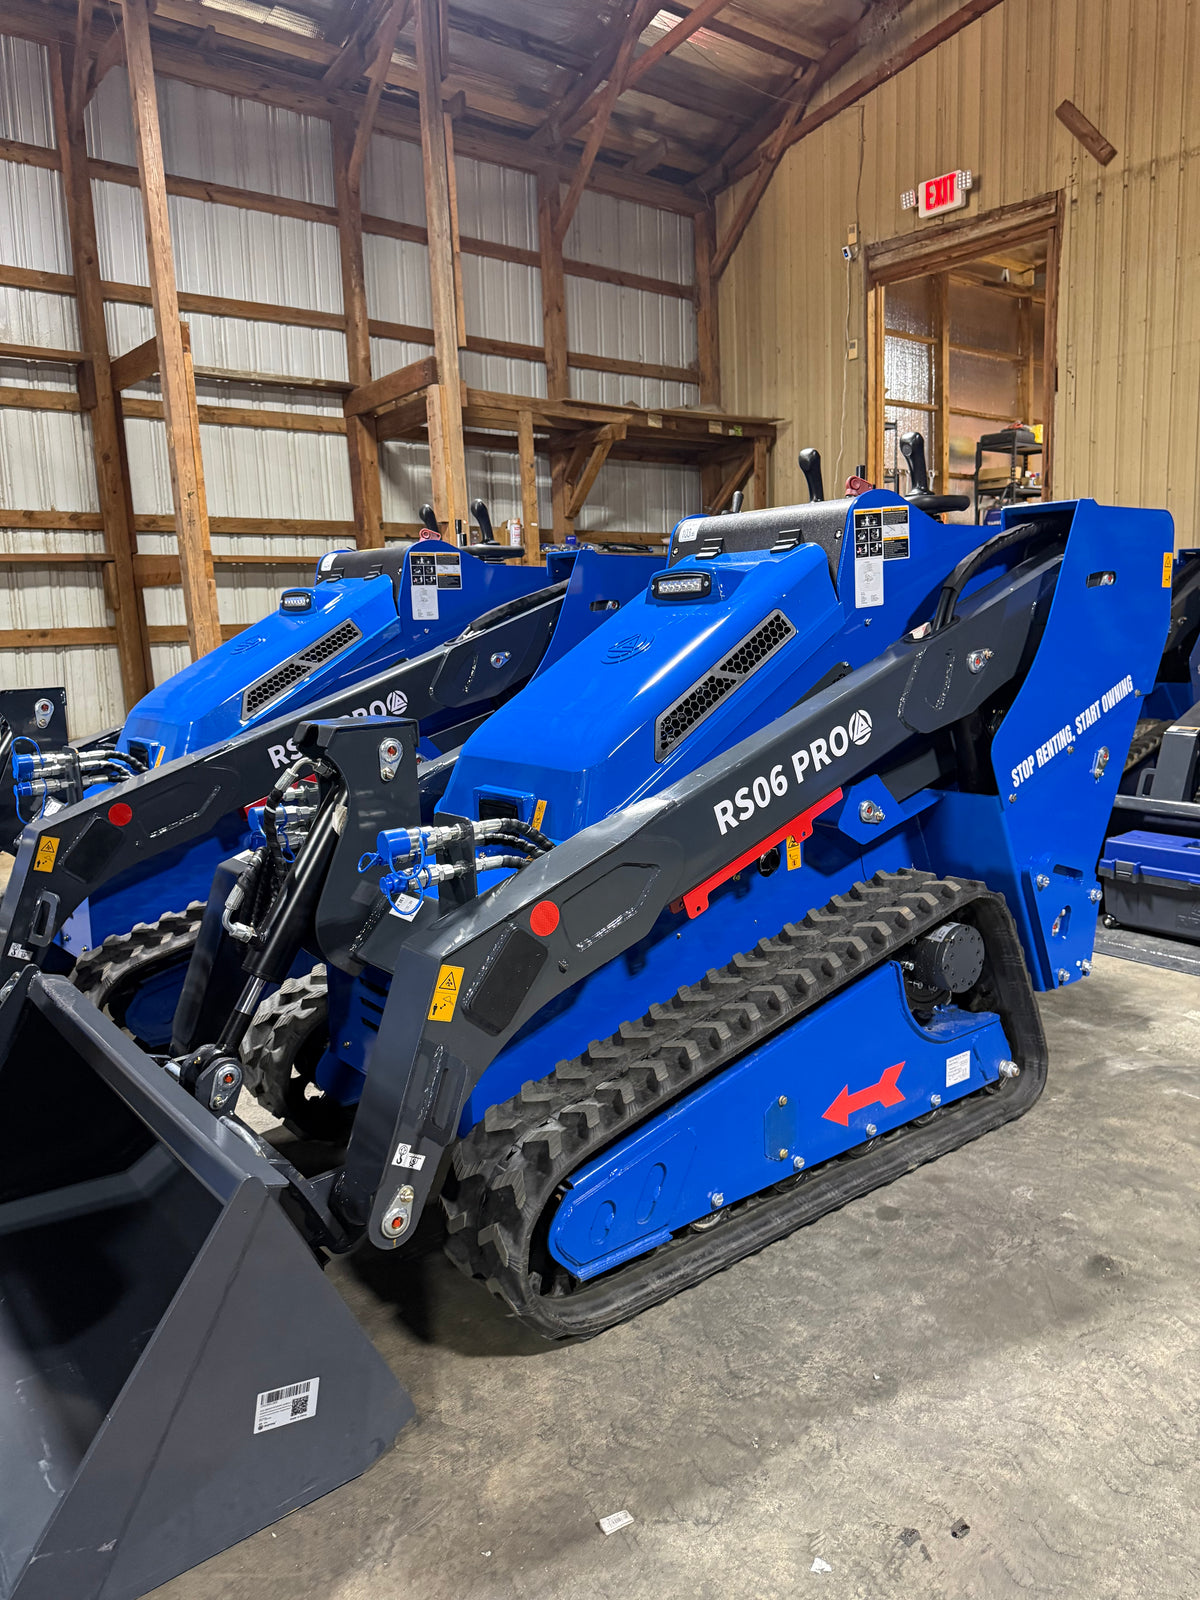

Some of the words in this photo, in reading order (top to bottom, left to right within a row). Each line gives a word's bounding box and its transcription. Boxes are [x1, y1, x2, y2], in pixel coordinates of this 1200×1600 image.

[925, 173, 957, 211] EXIT
[267, 737, 303, 769] RS
[1011, 754, 1035, 788] STOP
[1035, 724, 1076, 768] RENTING,
[1074, 700, 1101, 735] START
[1101, 674, 1134, 713] OWNING
[713, 765, 788, 836] RS06
[791, 725, 849, 784] PRO
